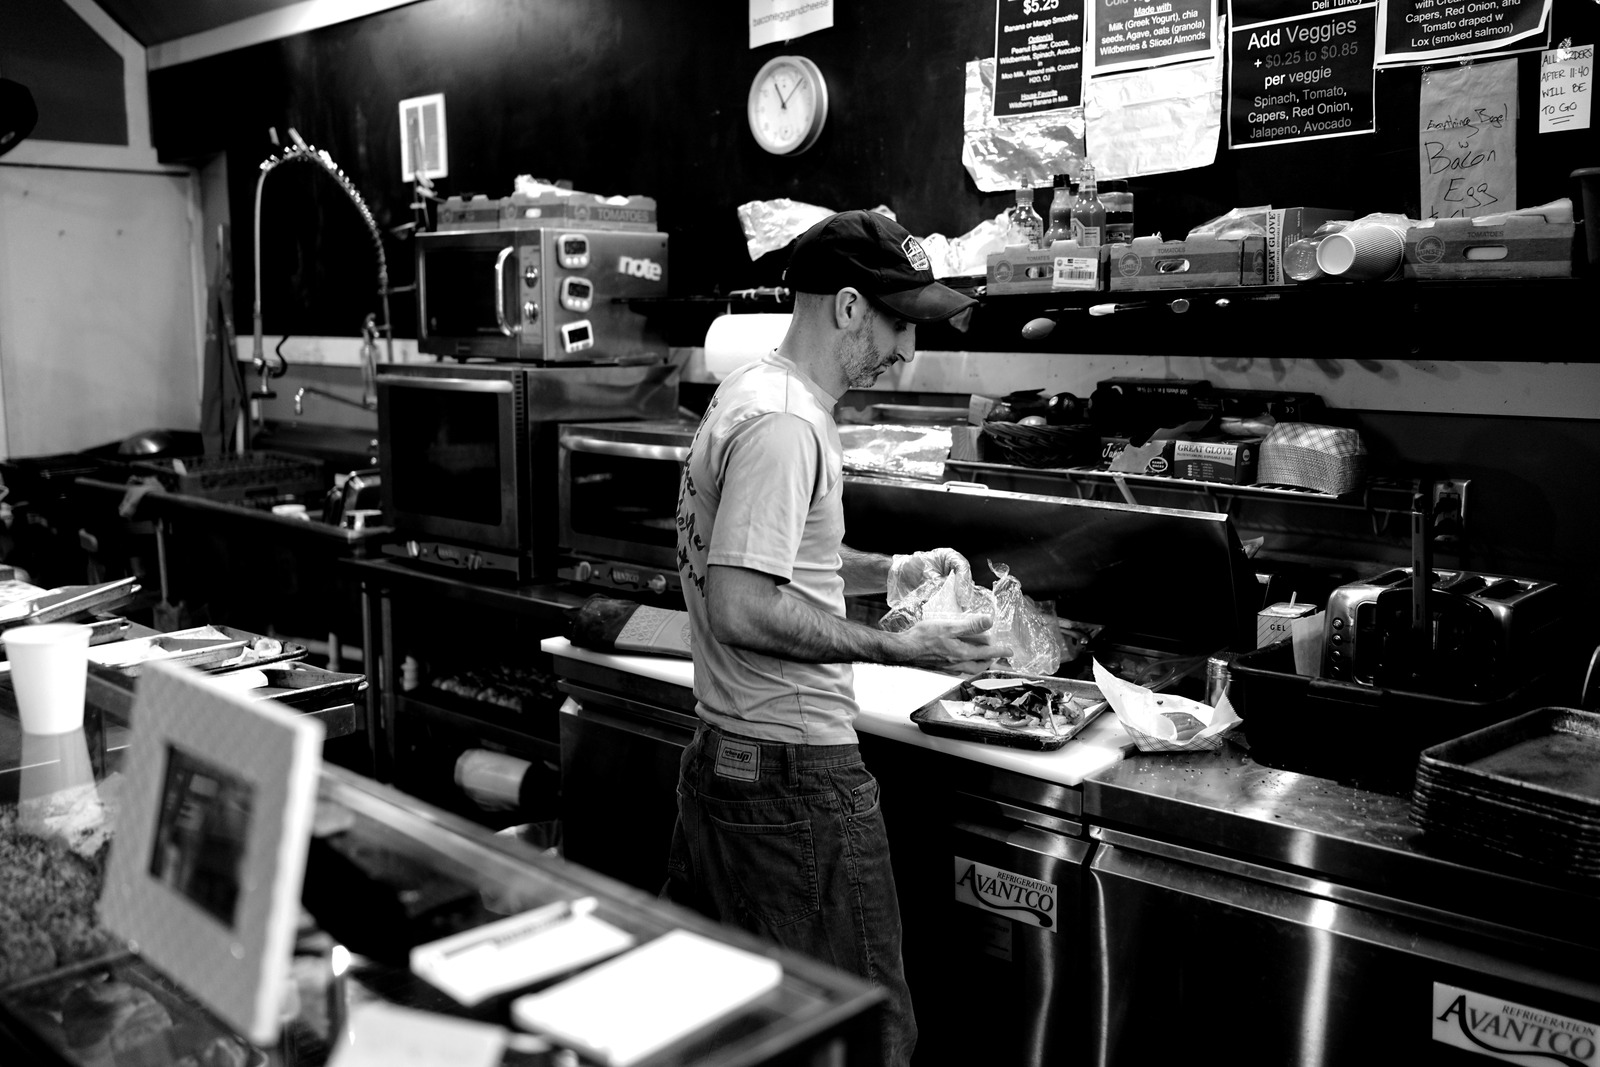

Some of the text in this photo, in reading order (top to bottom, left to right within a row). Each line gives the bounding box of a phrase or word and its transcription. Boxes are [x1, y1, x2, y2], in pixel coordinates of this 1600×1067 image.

[1023, 0, 1060, 15] $5.25
[1134, 2, 1172, 17] Made with
[1312, 1, 1329, 10] Deli
[1405, 11, 1442, 24] Capers,
[1445, 6, 1465, 17] Red
[1467, 2, 1499, 13] Onion,
[1415, 0, 1434, 10] with
[1004, 25, 1026, 33] Banana
[1032, 19, 1052, 27] Mango
[1052, 13, 1079, 24] Smoothie
[1108, 10, 1198, 32] Milk (Greek Yogurt), chia
[1422, 13, 1504, 33] Tomato draped w
[1100, 31, 1206, 56] Wildberries & Sliced Almonds
[1101, 20, 1206, 45] seeds, Agave, oats (granola)
[1248, 19, 1357, 50] Add Veggies
[1411, 23, 1514, 47] Lox (smoked salmon)
[1057, 46, 1081, 55] Avocado
[1254, 42, 1358, 68] + $0.25 to $0.85
[1542, 48, 1592, 67] ALL RDERS
[1026, 68, 1045, 76] Almond
[1057, 62, 1079, 72] Coconut
[1043, 74, 1051, 82] OJ
[1265, 66, 1332, 90] per veggie
[1541, 66, 1590, 83] AFTER 11:40
[1254, 86, 1347, 109] Spinach, Tomato,
[1542, 82, 1587, 98] WILL BE
[1033, 98, 1052, 106] Banana
[1248, 101, 1354, 124] Capers, Red Onion,
[1542, 102, 1578, 115] TO GO
[1474, 103, 1508, 128] Bagel
[1250, 117, 1352, 139] Jalapeno, Avocado
[1424, 142, 1496, 175] Bacon
[1444, 177, 1498, 209] Egg
[598, 208, 649, 222] TOMATOES
[619, 256, 662, 281] note
[1178, 444, 1204, 453] GREAT
[997, 872, 1055, 894] REFRIGERATION
[956, 863, 1054, 926] AVANTCO
[1436, 995, 1596, 1064] AVANTCO
[1502, 1005, 1596, 1036] REFRIGERATION
